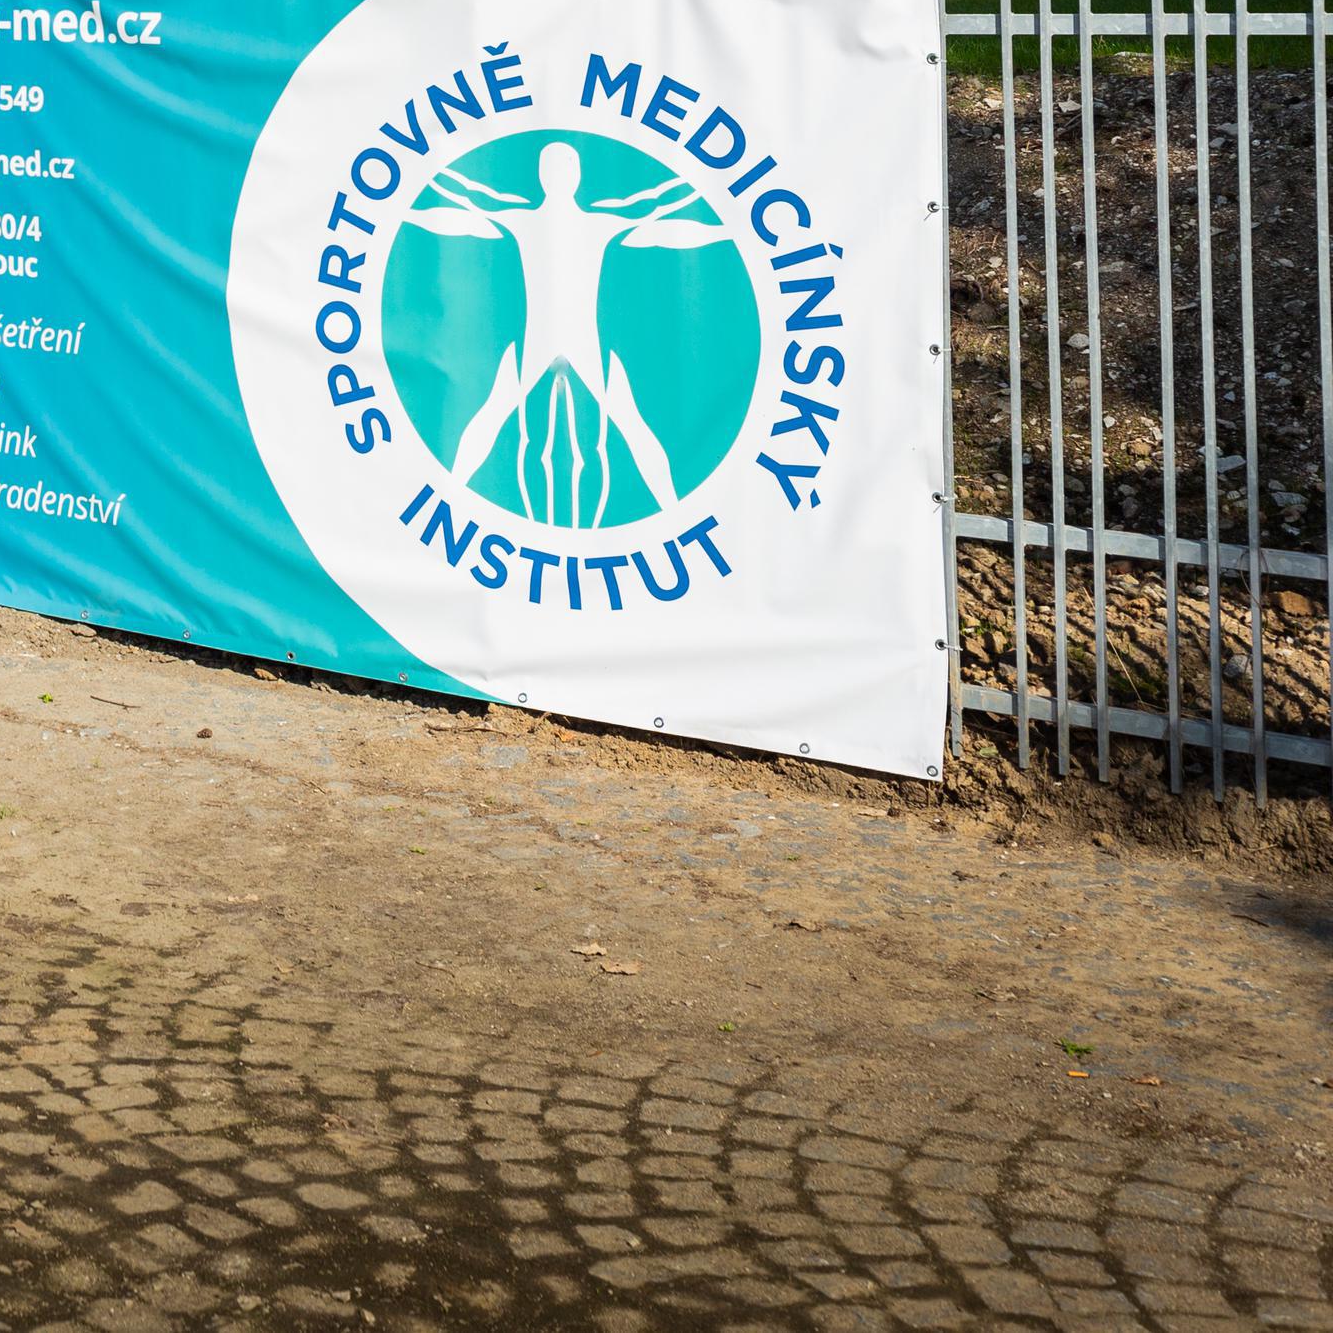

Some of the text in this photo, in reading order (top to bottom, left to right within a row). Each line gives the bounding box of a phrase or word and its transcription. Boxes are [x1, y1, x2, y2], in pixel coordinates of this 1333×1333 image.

[0, 84, 44, 112] 549
[315, 41, 845, 512] SPORTOVNĚ MEDICÍNSKÝ
[399, 483, 733, 611] INSTITUT
